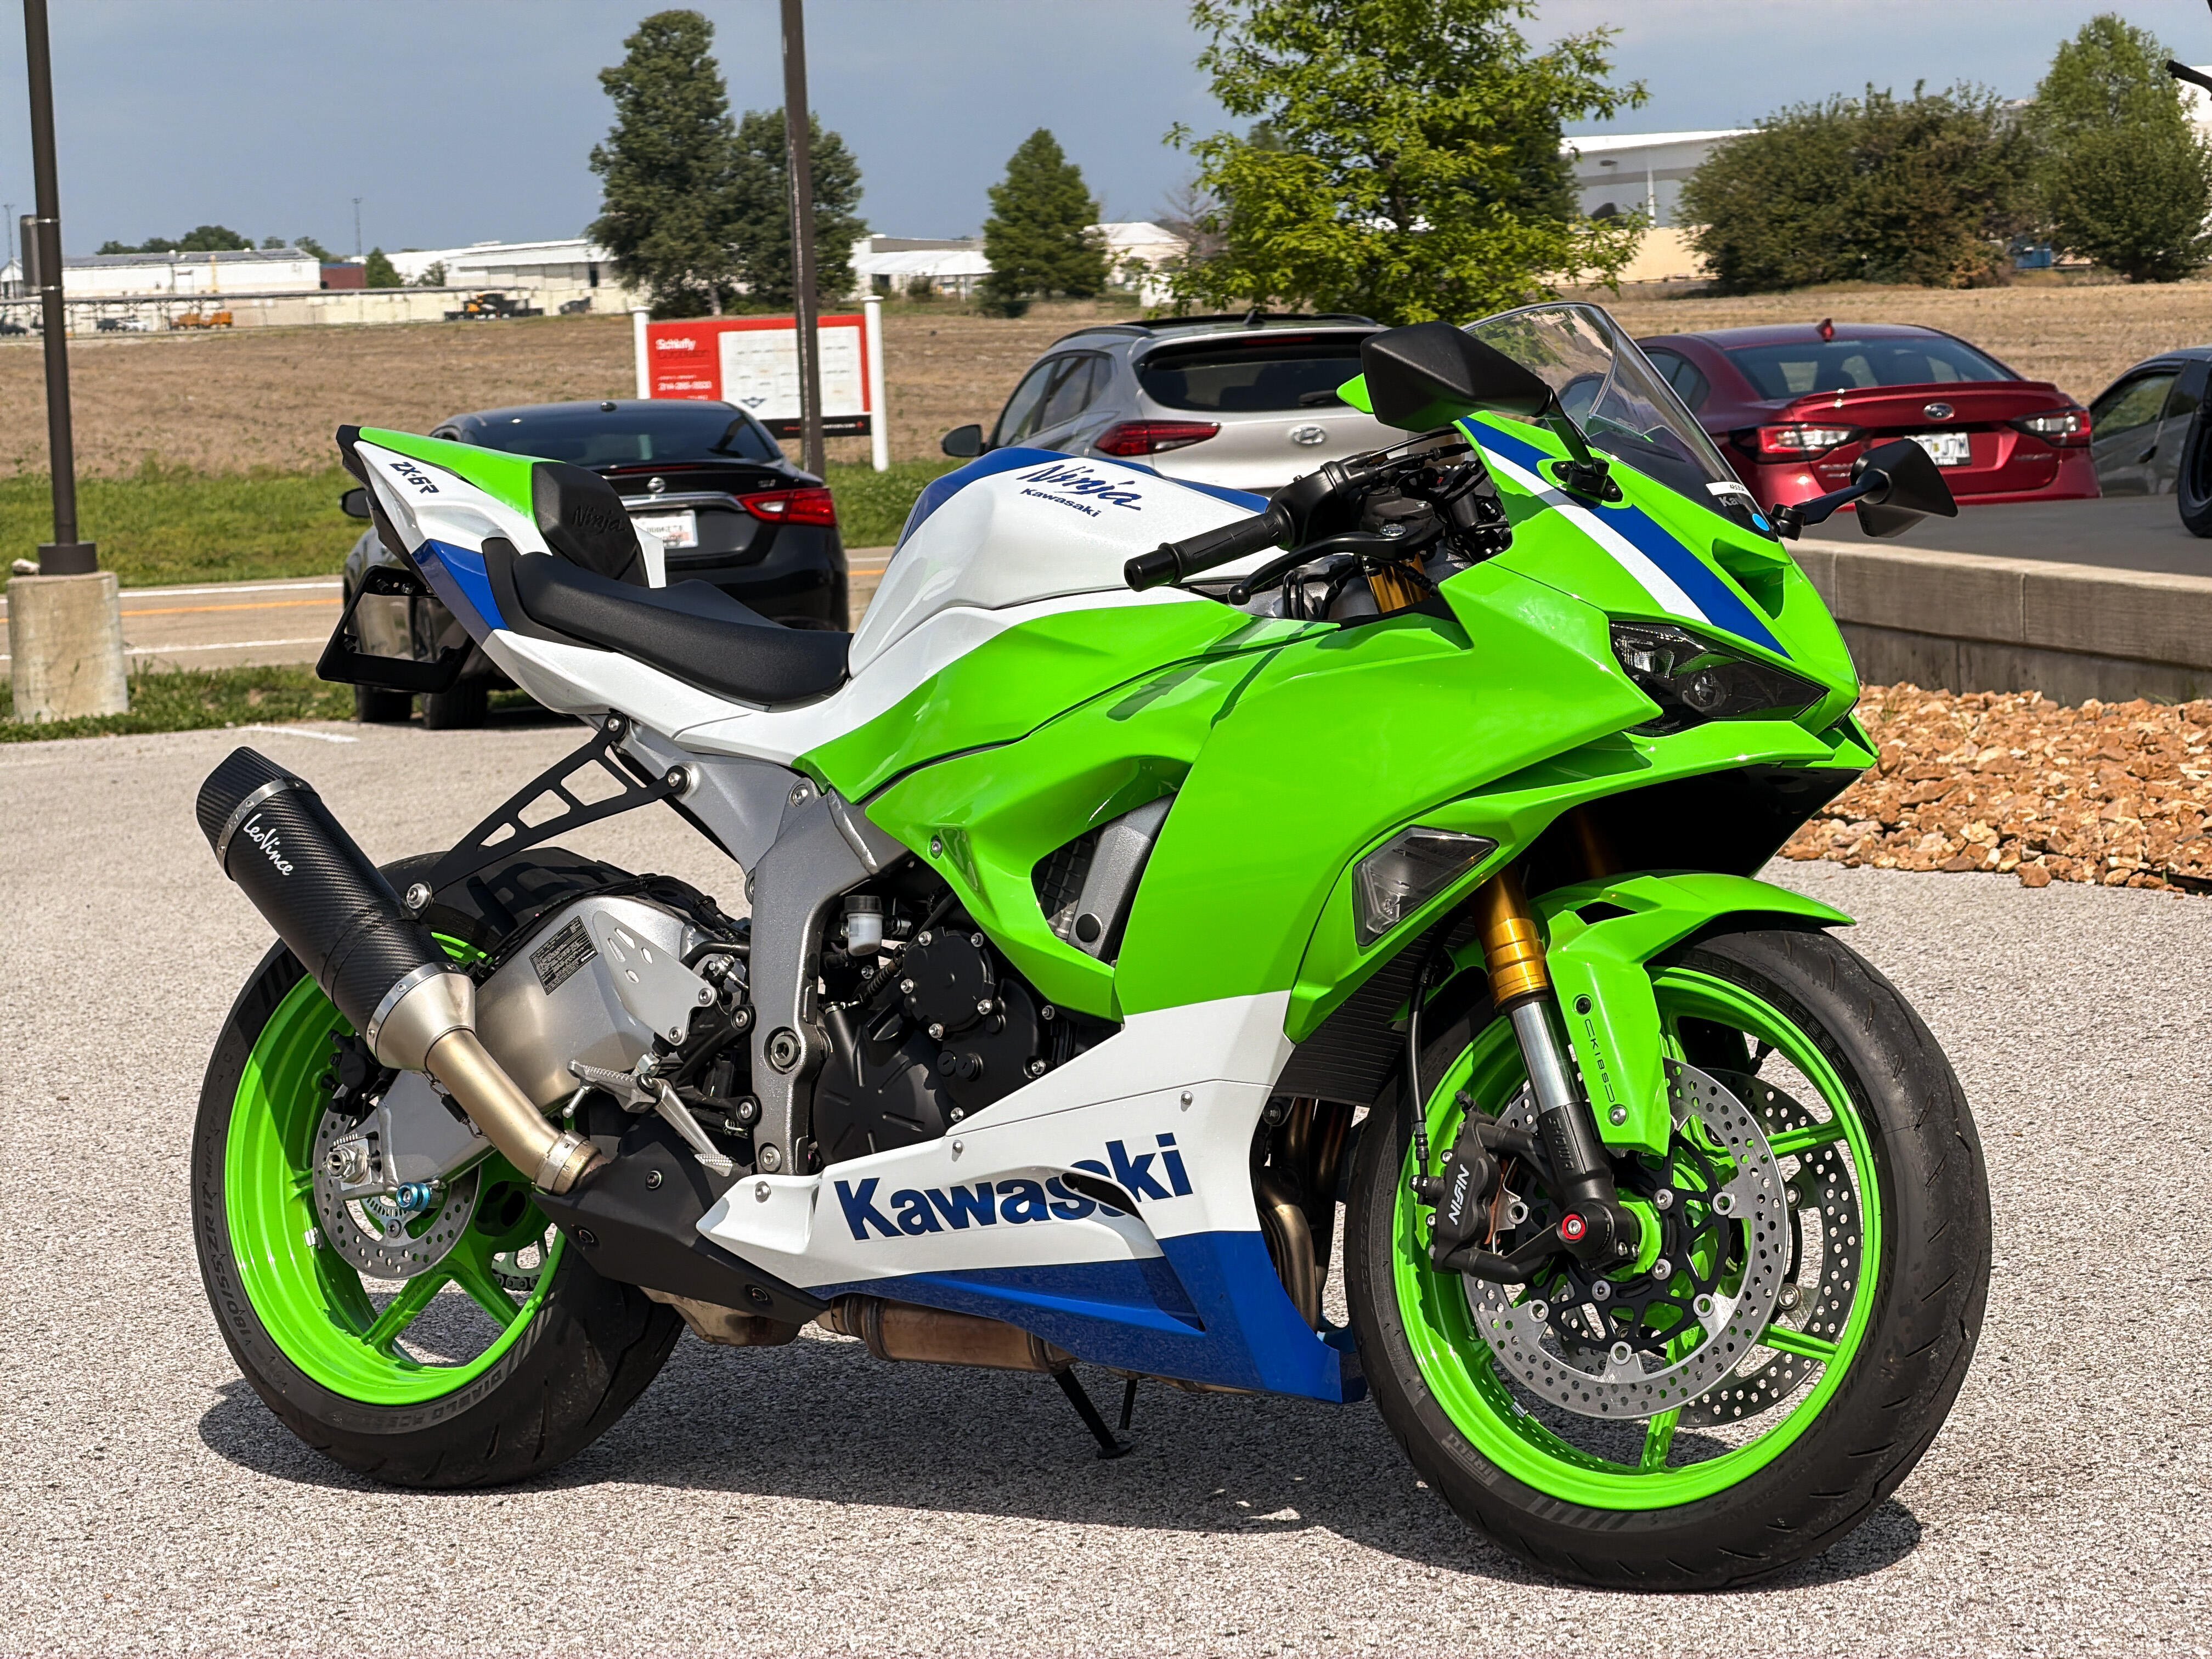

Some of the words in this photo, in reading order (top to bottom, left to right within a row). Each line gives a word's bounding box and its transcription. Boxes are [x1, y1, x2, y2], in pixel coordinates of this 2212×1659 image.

[388, 461, 440, 494] ZX-6R
[1016, 465, 1142, 511] Ninja
[1020, 488, 1102, 517] Kawasaki
[572, 505, 626, 535] Ninja
[243, 813, 294, 876] LeoVince
[1777, 992, 1848, 1069] ROSSO
[1548, 1117, 1575, 1170] SHOWA
[1448, 1164, 1470, 1226] NISSIN
[1441, 1432, 1500, 1486] PIRELLI
